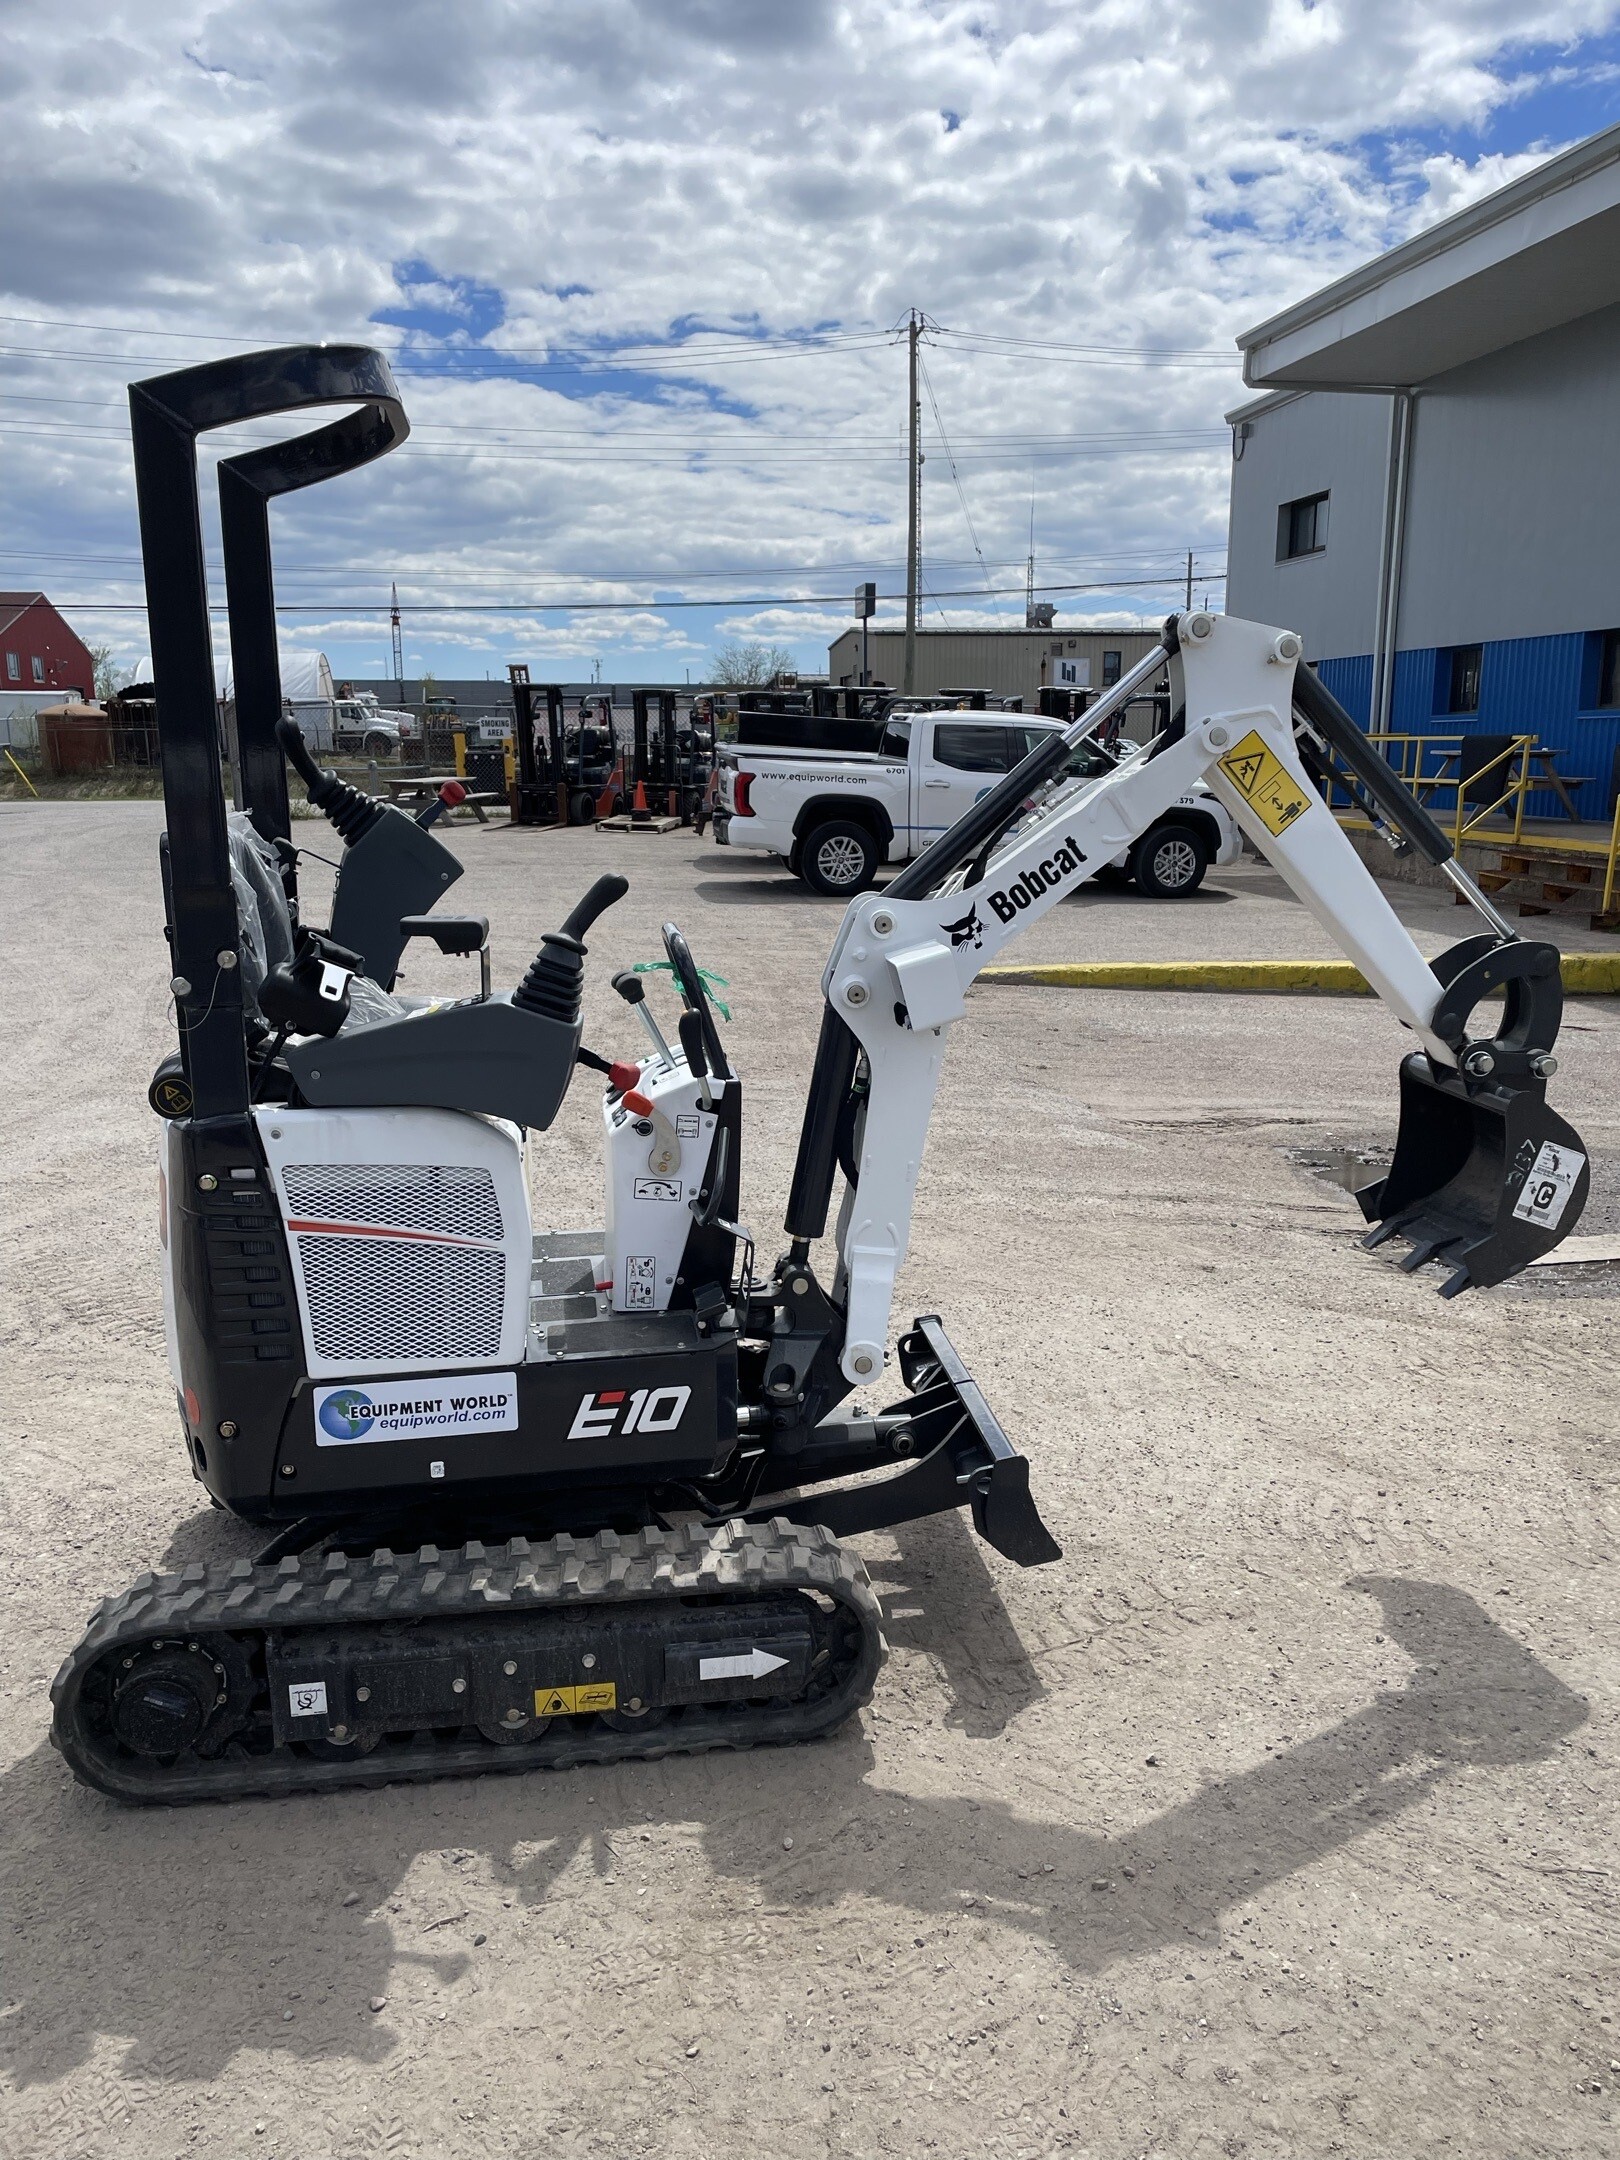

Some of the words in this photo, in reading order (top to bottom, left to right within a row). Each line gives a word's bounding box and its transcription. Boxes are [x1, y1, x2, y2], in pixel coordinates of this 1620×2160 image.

[480, 719, 510, 728] SMOKING
[487, 728, 504, 737] AREA
[761, 772, 867, 785] www.equipworld.com
[886, 767, 906, 775] 6701
[986, 835, 1089, 925] Bobcat
[1537, 1186, 1553, 1204] C
[350, 1399, 443, 1419] EQUIPMENT
[566, 1385, 692, 1440] E10
[380, 1409, 506, 1431] equipworld.com
